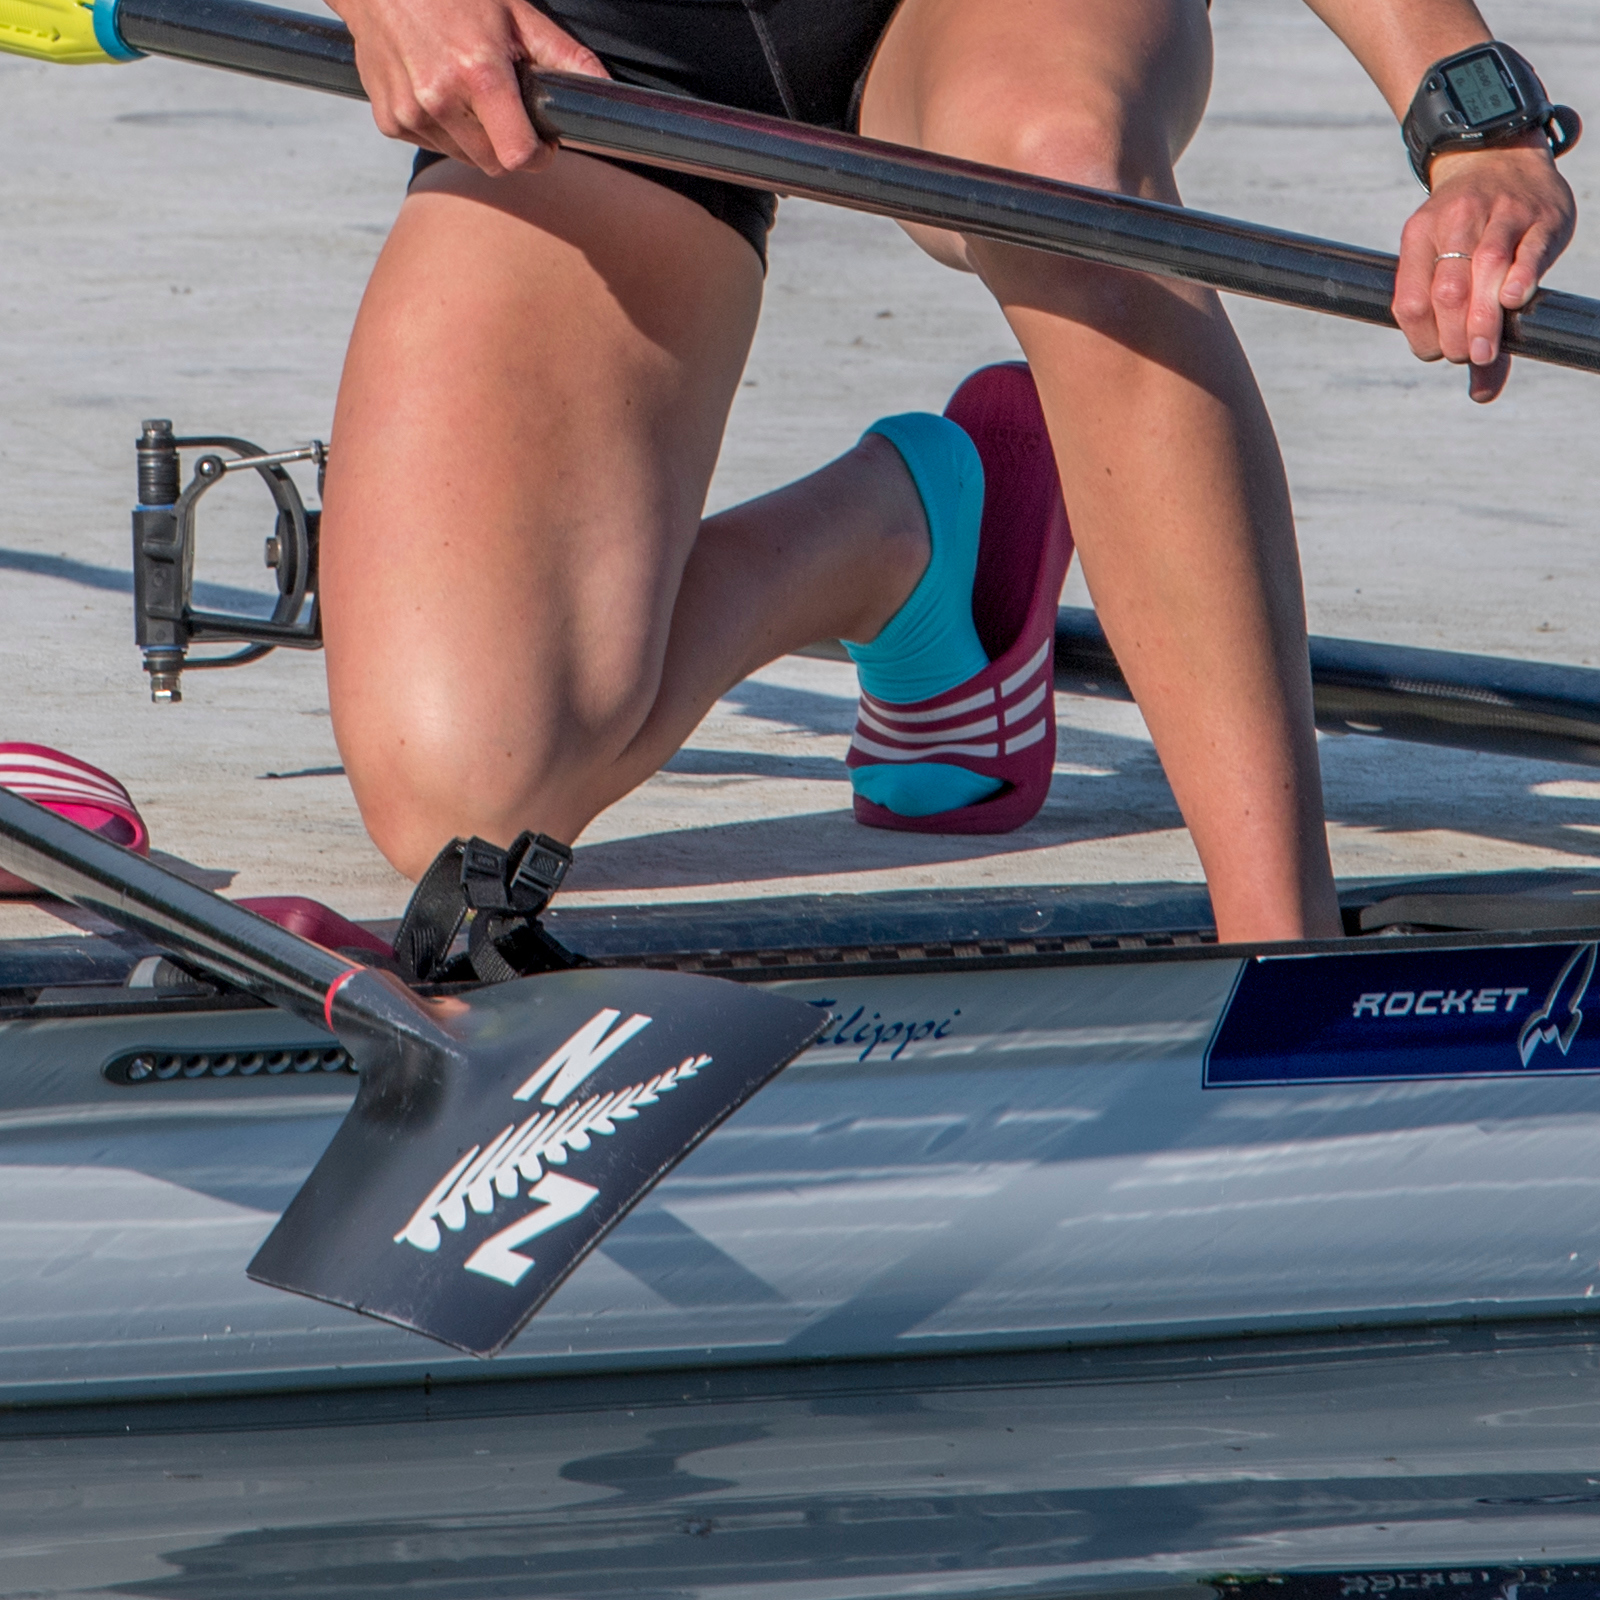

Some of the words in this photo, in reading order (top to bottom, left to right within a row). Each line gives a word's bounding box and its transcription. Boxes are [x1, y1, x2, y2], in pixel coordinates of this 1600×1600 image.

[1353, 987, 1529, 1017] ROCKET
[511, 1007, 653, 1107] N
[463, 1170, 600, 1287] Z
